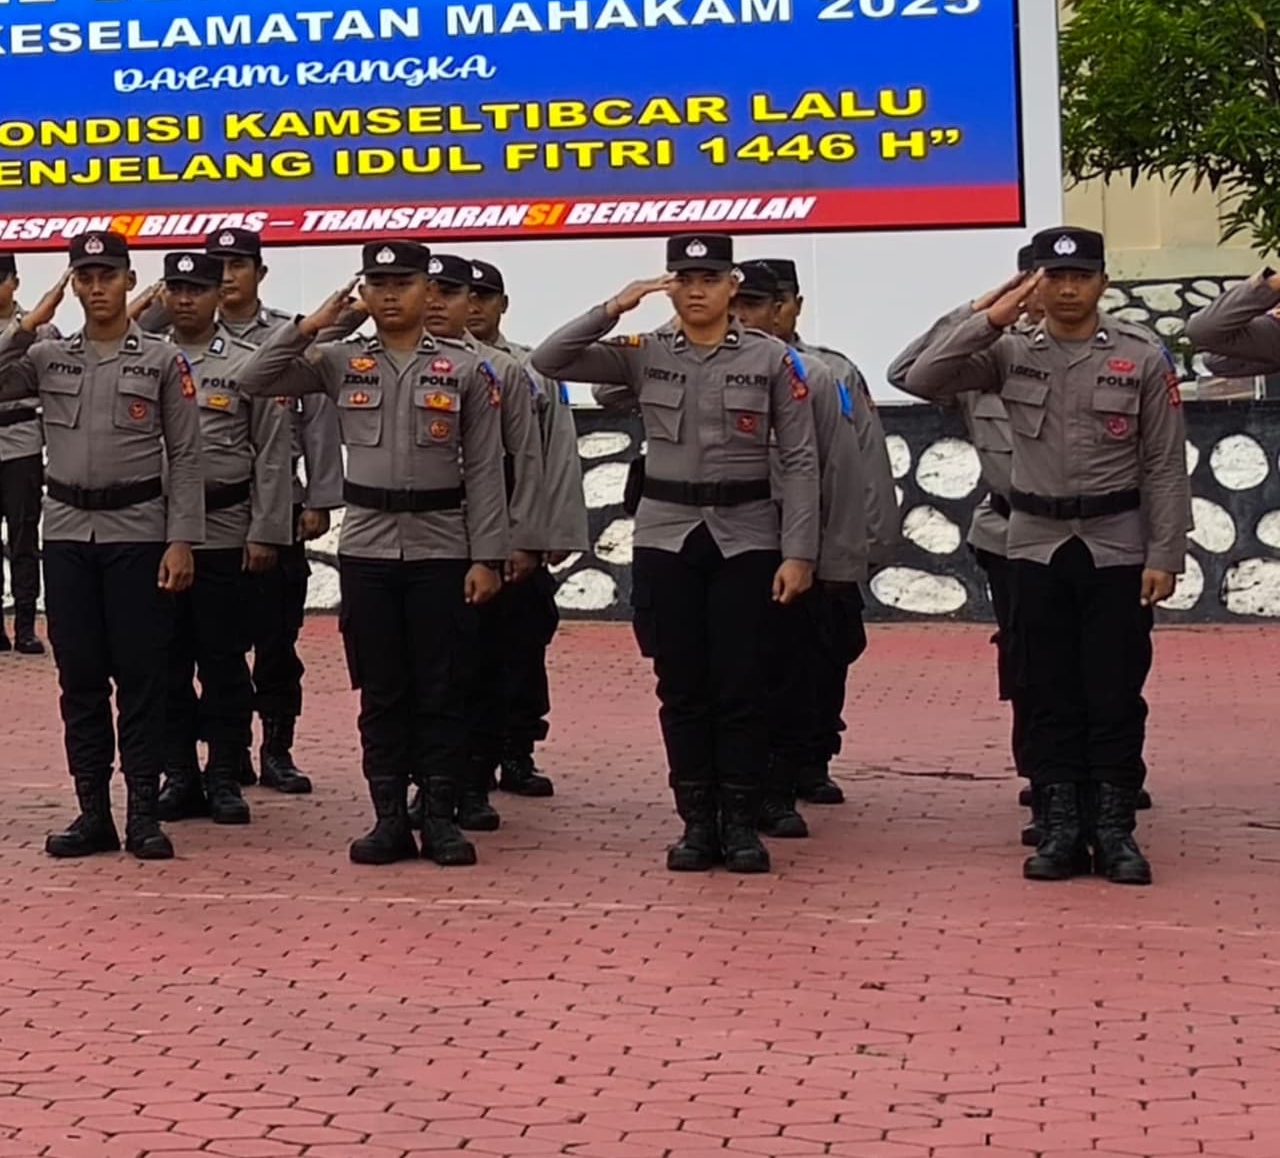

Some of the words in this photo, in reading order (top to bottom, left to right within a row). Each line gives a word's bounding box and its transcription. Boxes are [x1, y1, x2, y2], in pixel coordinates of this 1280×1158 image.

[295, 54, 496, 87] RANGKA
[225, 95, 728, 141] KAMSELTIBCAR
[752, 89, 923, 121] LALU
[335, 147, 483, 176] IDUL
[505, 139, 672, 170] FITRI
[699, 134, 856, 164] 1446
[881, 128, 961, 159] H”
[300, 202, 566, 231] TRANSPARANSI
[566, 196, 817, 225] BERKEADILAN
[122, 365, 160, 379] POLRI
[420, 375, 459, 388] POLRI
[725, 373, 769, 387] POLRI
[1096, 376, 1141, 390] POLRI
